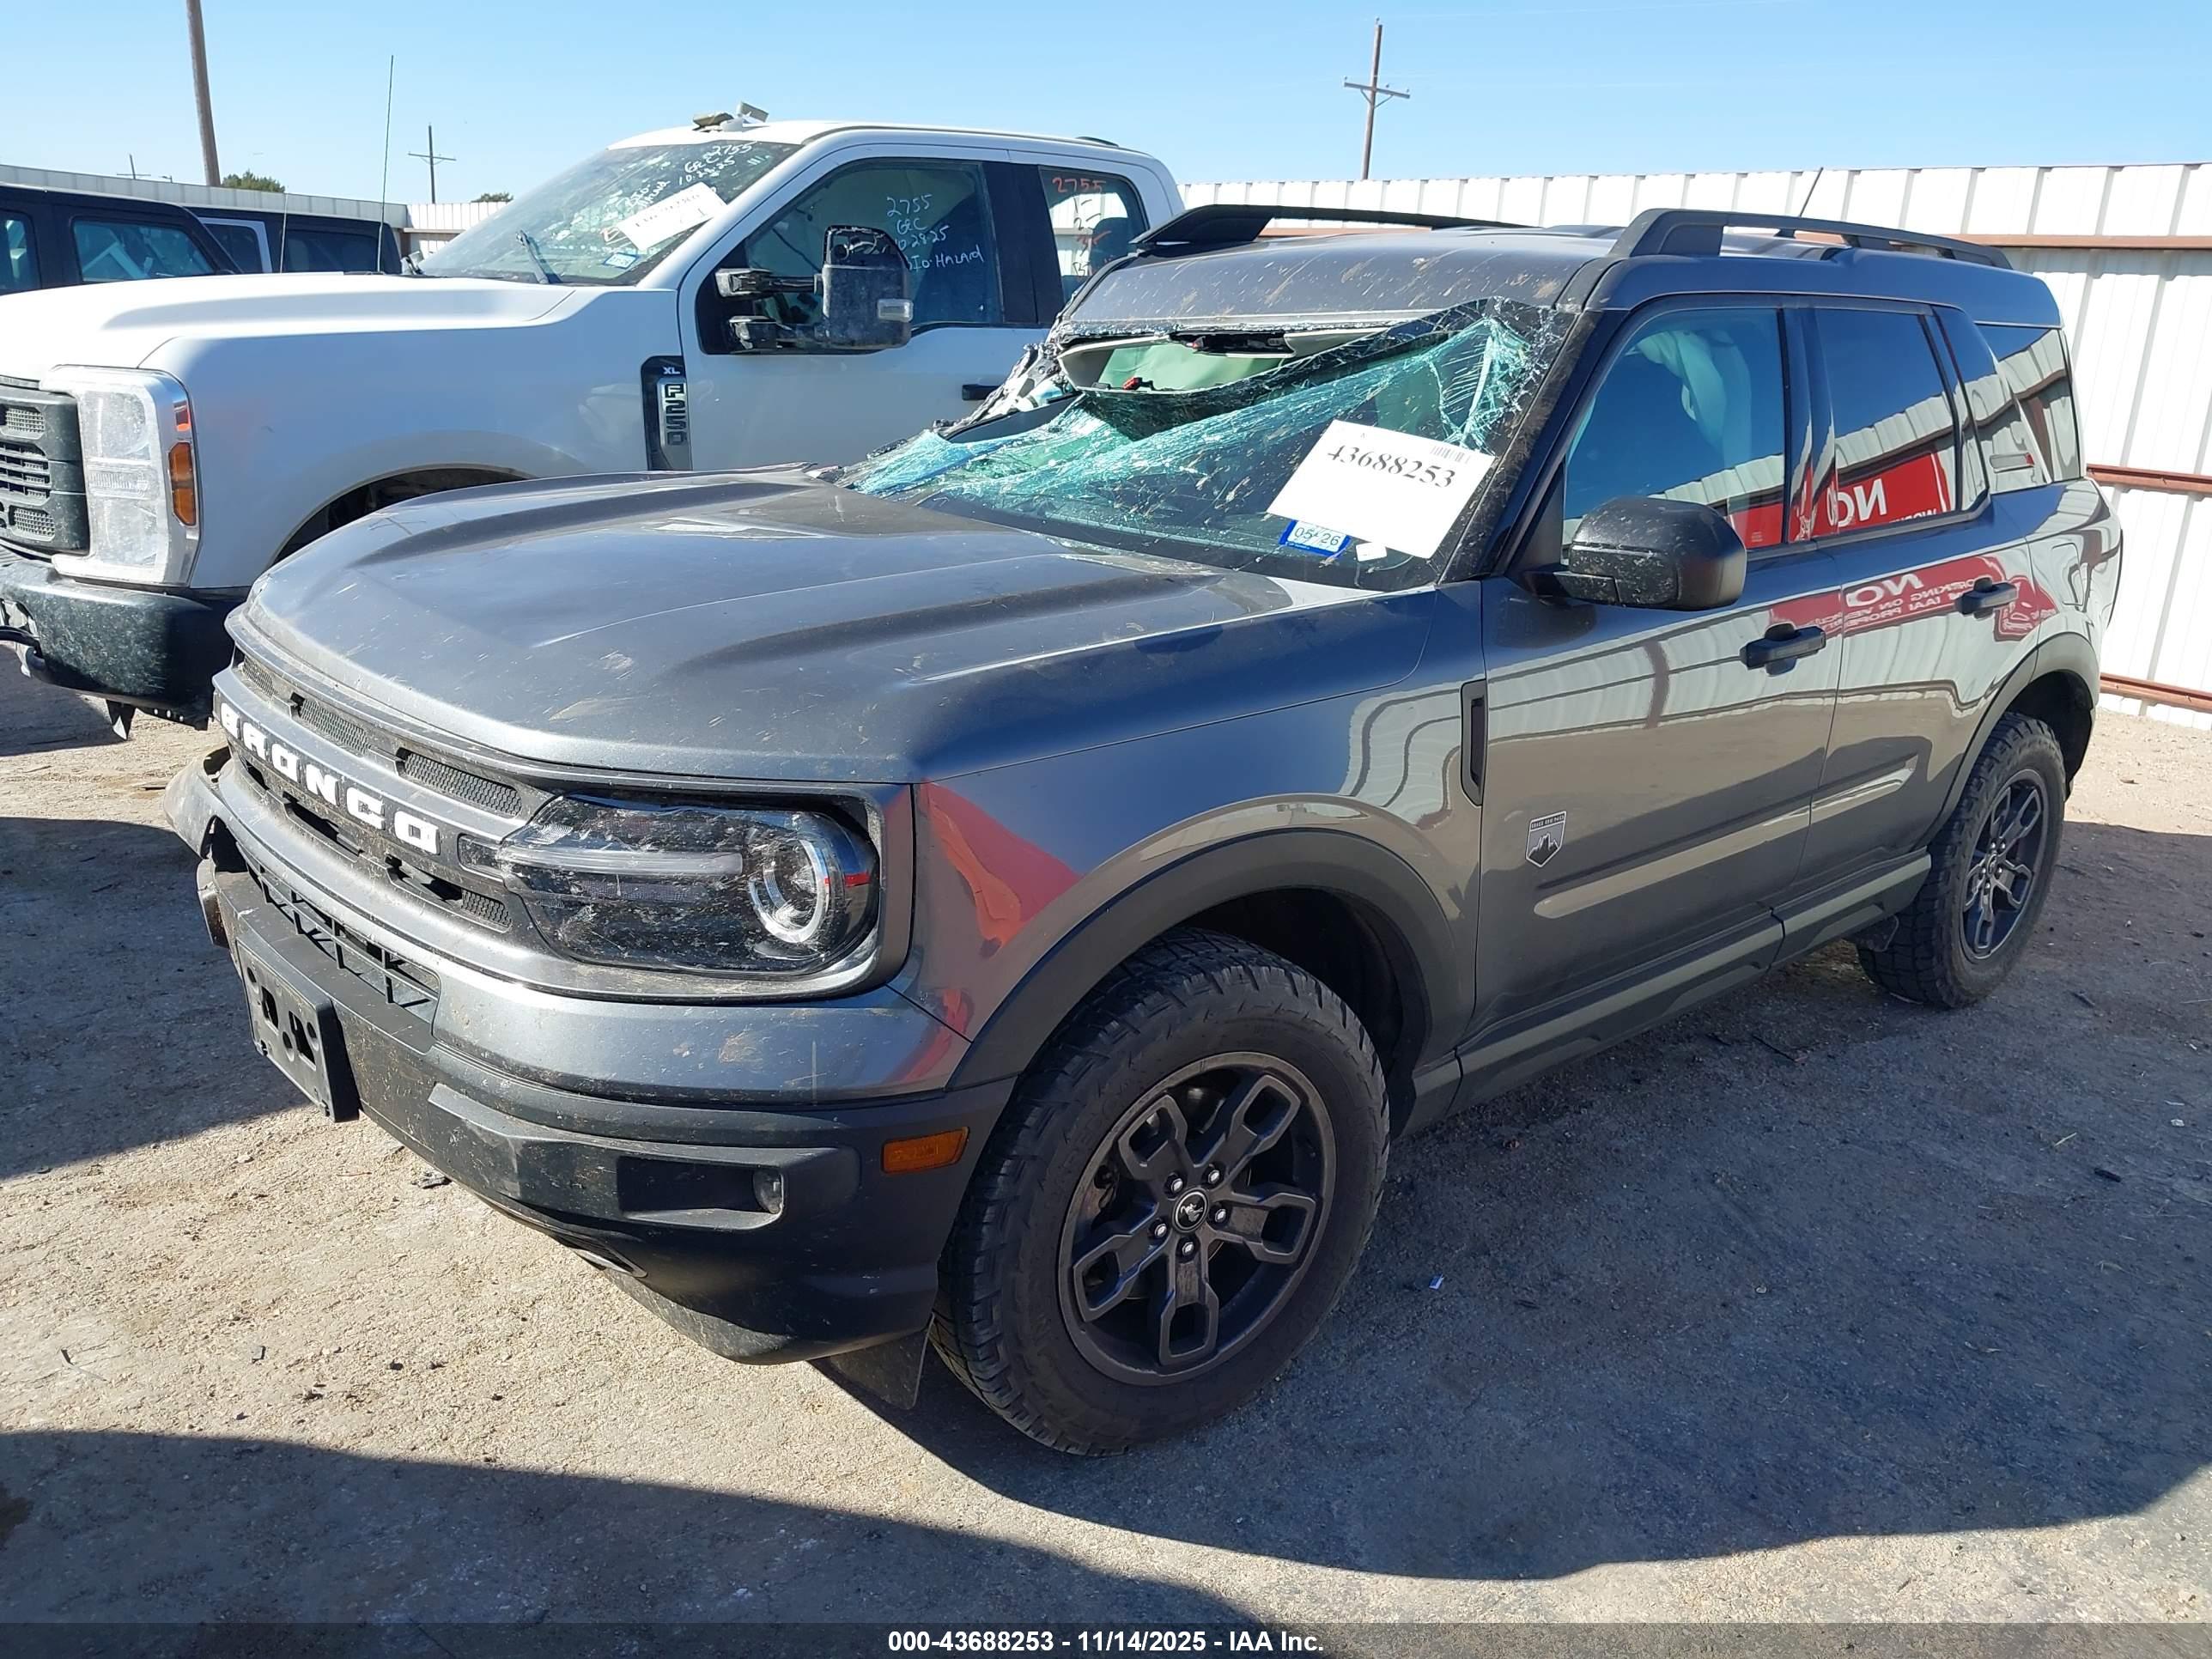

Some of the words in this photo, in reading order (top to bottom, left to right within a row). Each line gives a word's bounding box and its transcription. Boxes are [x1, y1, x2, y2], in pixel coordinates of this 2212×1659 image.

[886, 194, 933, 217] 2755
[663, 367, 681, 375] XL
[1327, 445, 1456, 488] 43688253
[221, 702, 441, 855] BRONCO
